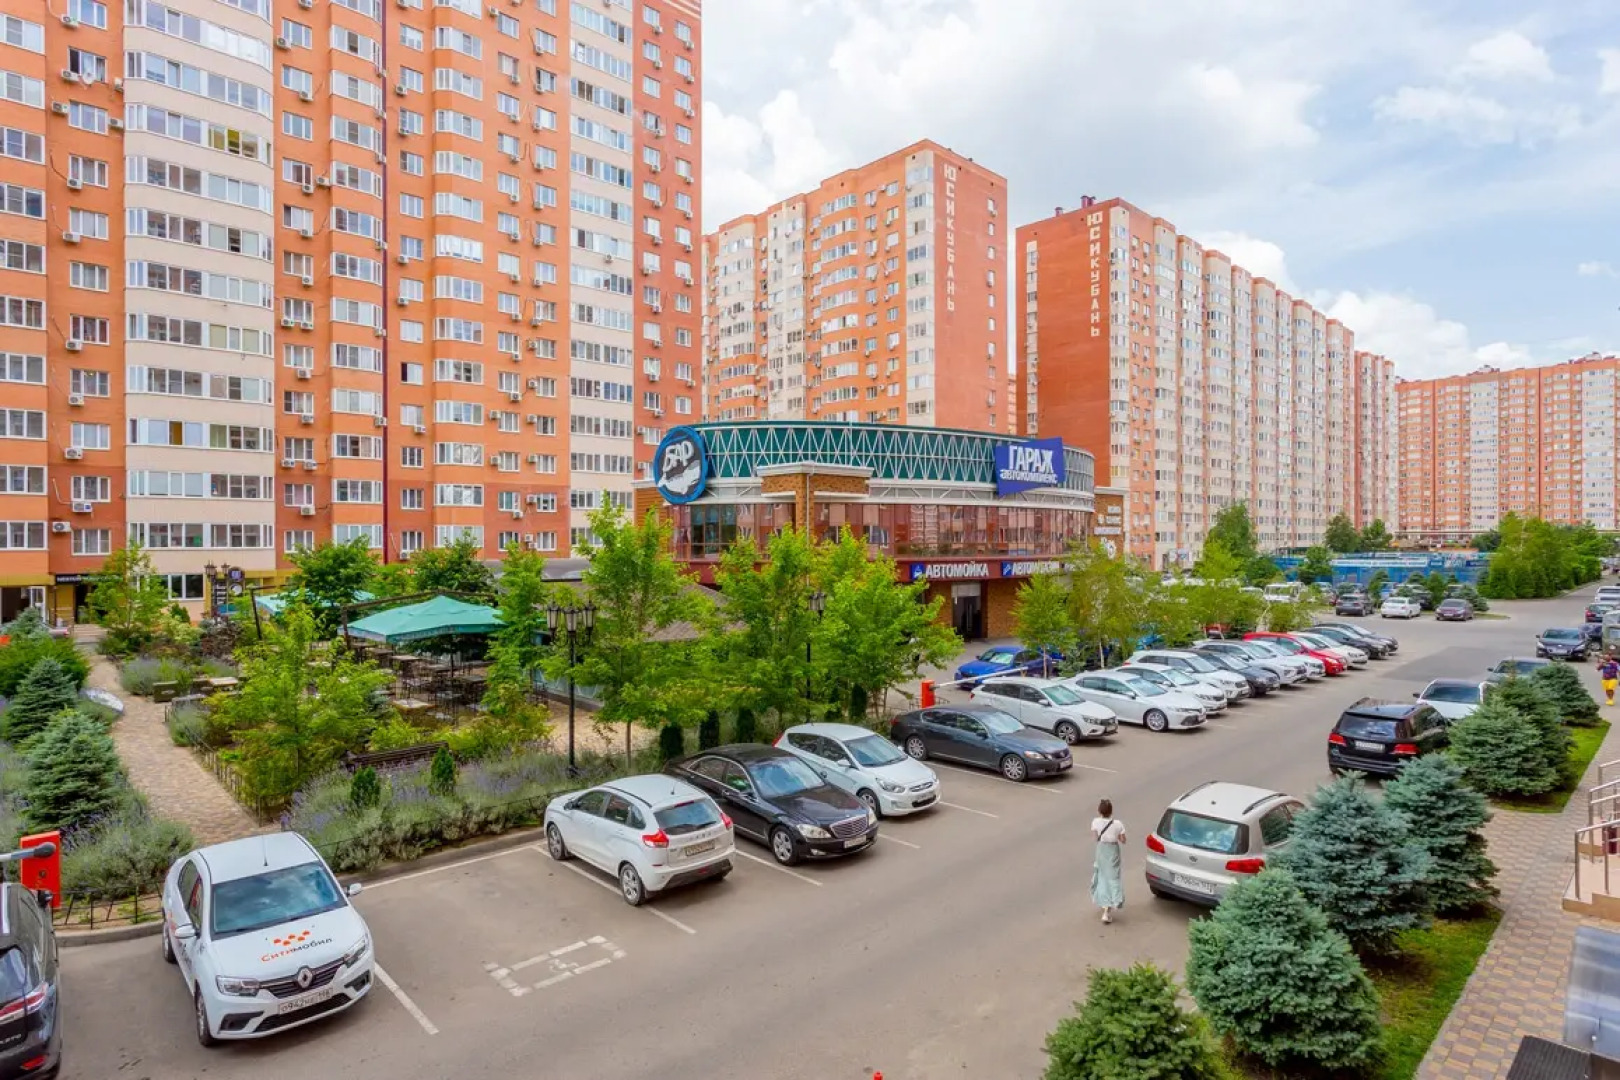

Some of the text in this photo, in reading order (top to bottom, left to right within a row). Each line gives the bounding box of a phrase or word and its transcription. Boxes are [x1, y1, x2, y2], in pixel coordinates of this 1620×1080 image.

[662, 440, 694, 472] БАР
[1009, 445, 1054, 473] ГАРАЖ
[925, 560, 989, 579] АВТОМОЙКА
[260, 938, 333, 962] Ситимобил
